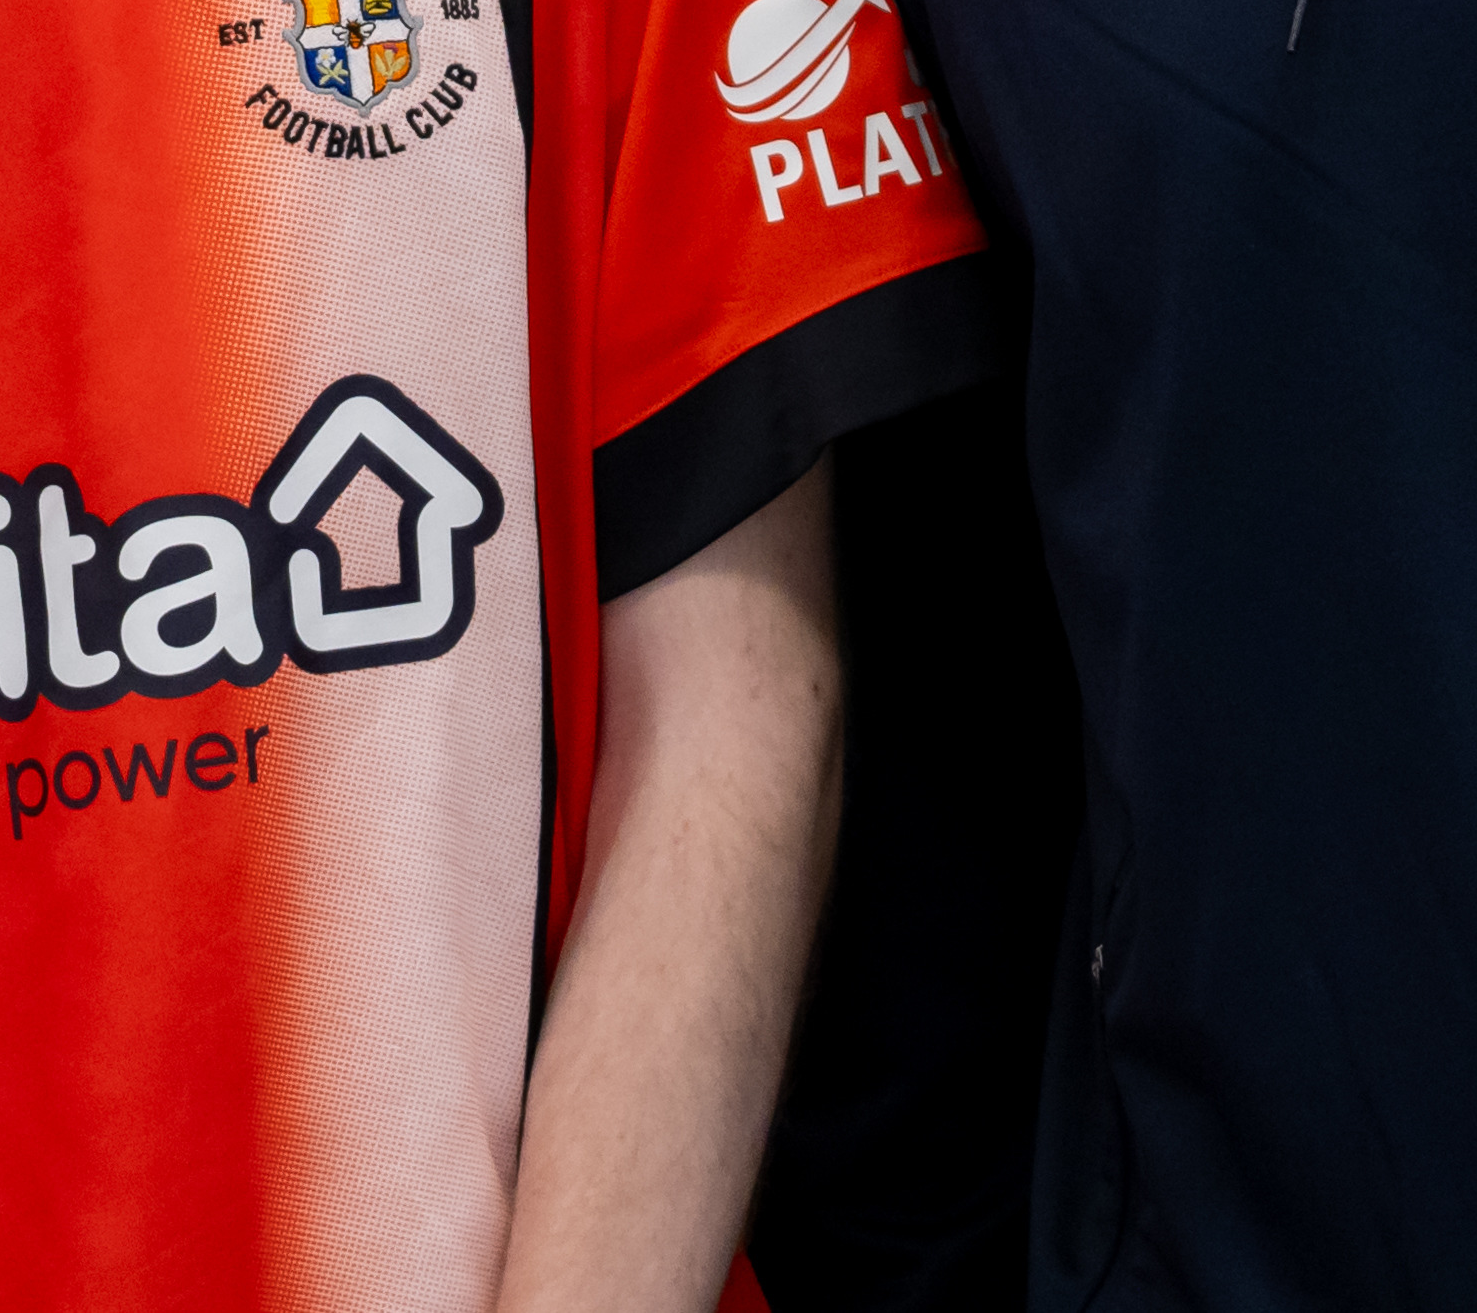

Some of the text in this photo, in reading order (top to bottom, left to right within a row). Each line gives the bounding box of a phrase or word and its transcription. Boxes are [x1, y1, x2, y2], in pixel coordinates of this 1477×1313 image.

[218, 19, 265, 47] EST
[245, 63, 478, 160] FOOTBALL CLUB
[750, 100, 956, 223] PLAT
[6, 723, 270, 841] power
